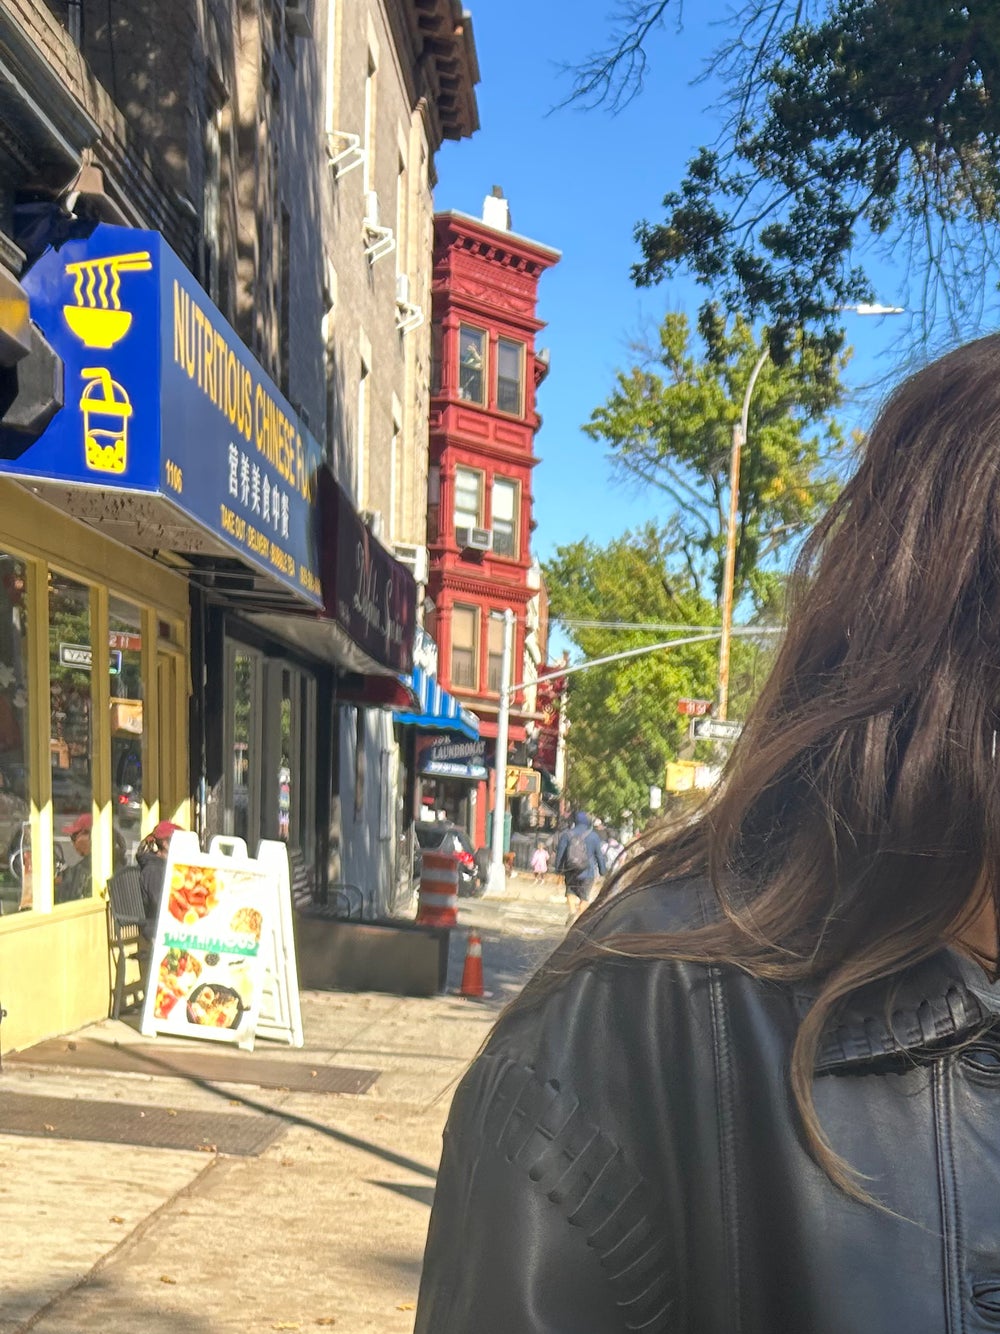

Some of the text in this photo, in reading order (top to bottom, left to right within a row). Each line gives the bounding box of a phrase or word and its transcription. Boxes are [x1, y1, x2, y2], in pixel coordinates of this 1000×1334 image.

[174, 279, 251, 441] NUTRITIOUS
[255, 383, 295, 487] CHINESE
[433, 741, 485, 760] LAUNDROMAT
